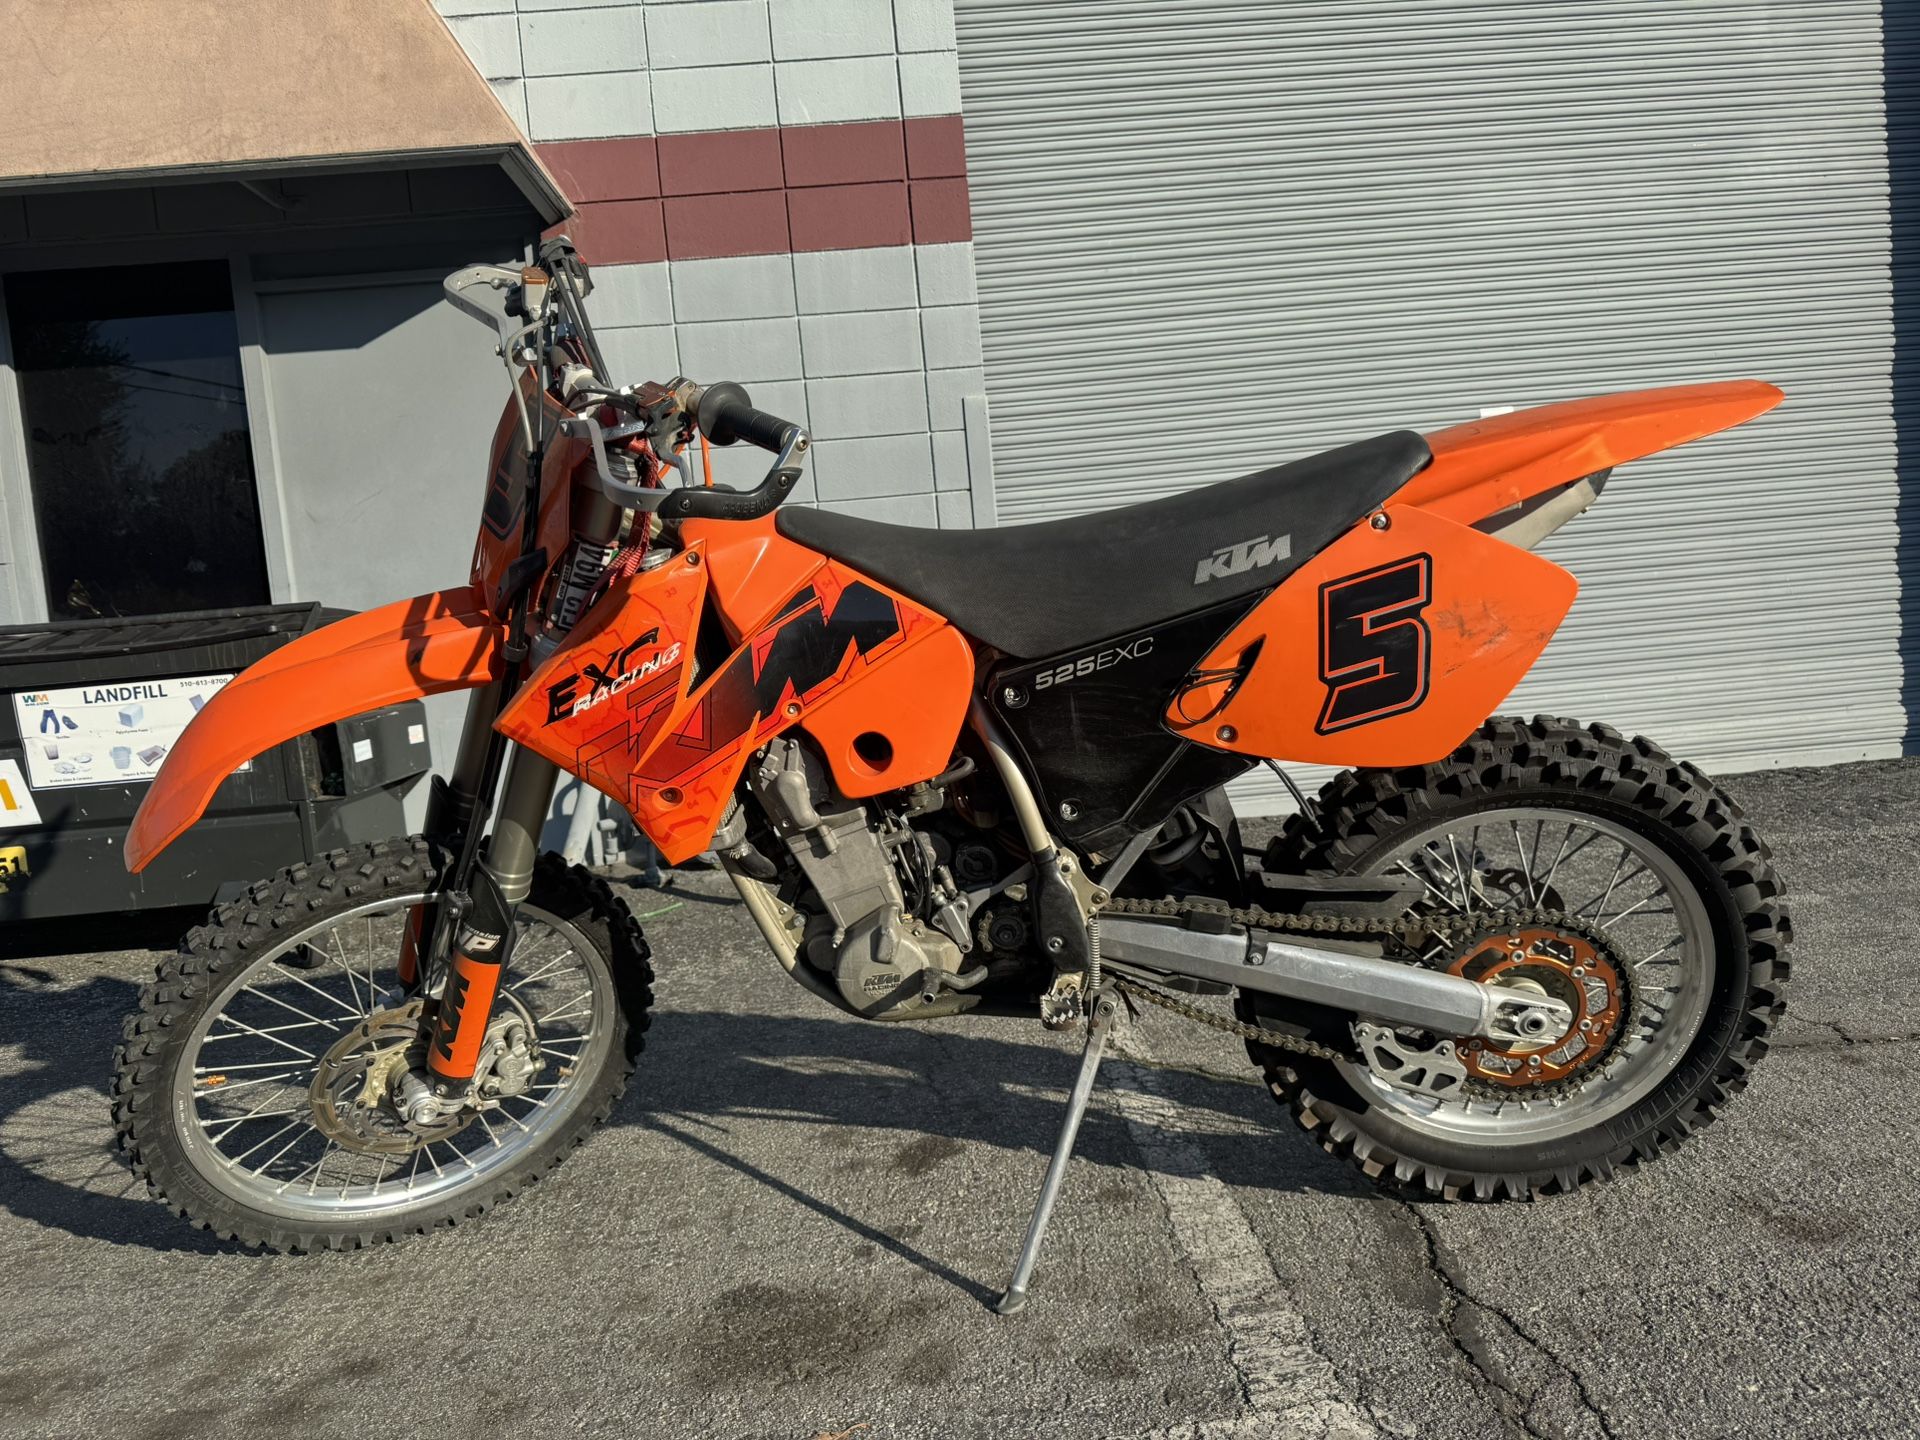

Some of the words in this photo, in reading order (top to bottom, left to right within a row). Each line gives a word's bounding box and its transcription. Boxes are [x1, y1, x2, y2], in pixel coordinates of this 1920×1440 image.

[1193, 534, 1292, 585] KTM
[1315, 551, 1432, 737] 5
[22, 693, 49, 704] WM
[82, 684, 168, 704] LANDFILL
[541, 626, 660, 729] EXC
[571, 642, 681, 718] RACING
